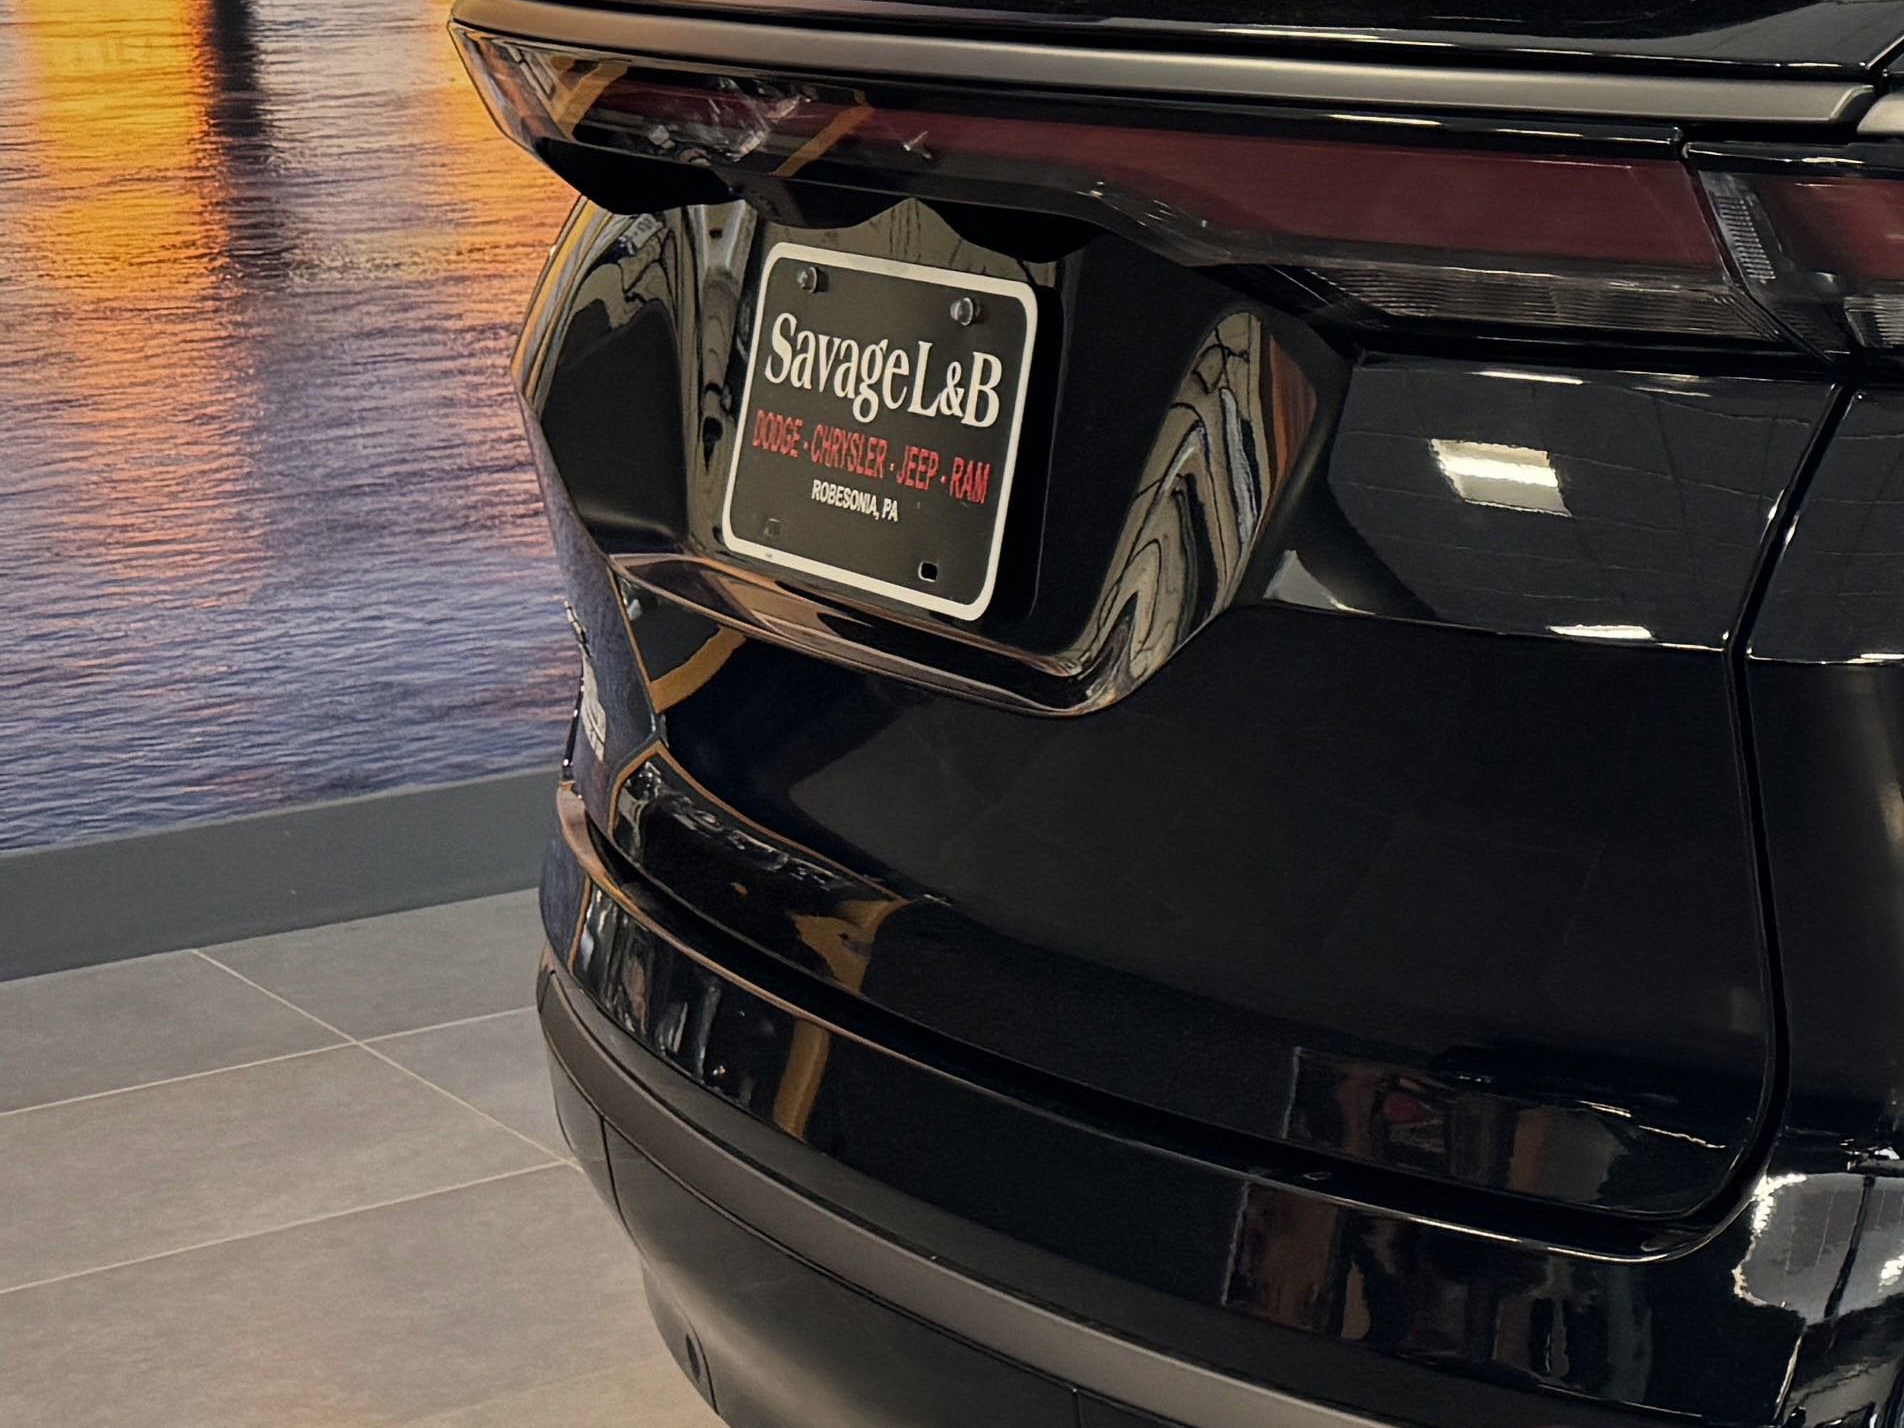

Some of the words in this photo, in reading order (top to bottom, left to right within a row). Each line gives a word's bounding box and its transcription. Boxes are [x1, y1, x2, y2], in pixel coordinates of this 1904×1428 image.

[764, 312, 910, 424] Savage
[908, 340, 1004, 429] L&B
[751, 409, 804, 459] DODGE
[810, 423, 889, 480] CHRYSLER
[896, 445, 941, 492] JEEP
[948, 456, 991, 505] RAM
[811, 479, 880, 521] ROBESONIA,
[881, 498, 899, 523] PA
